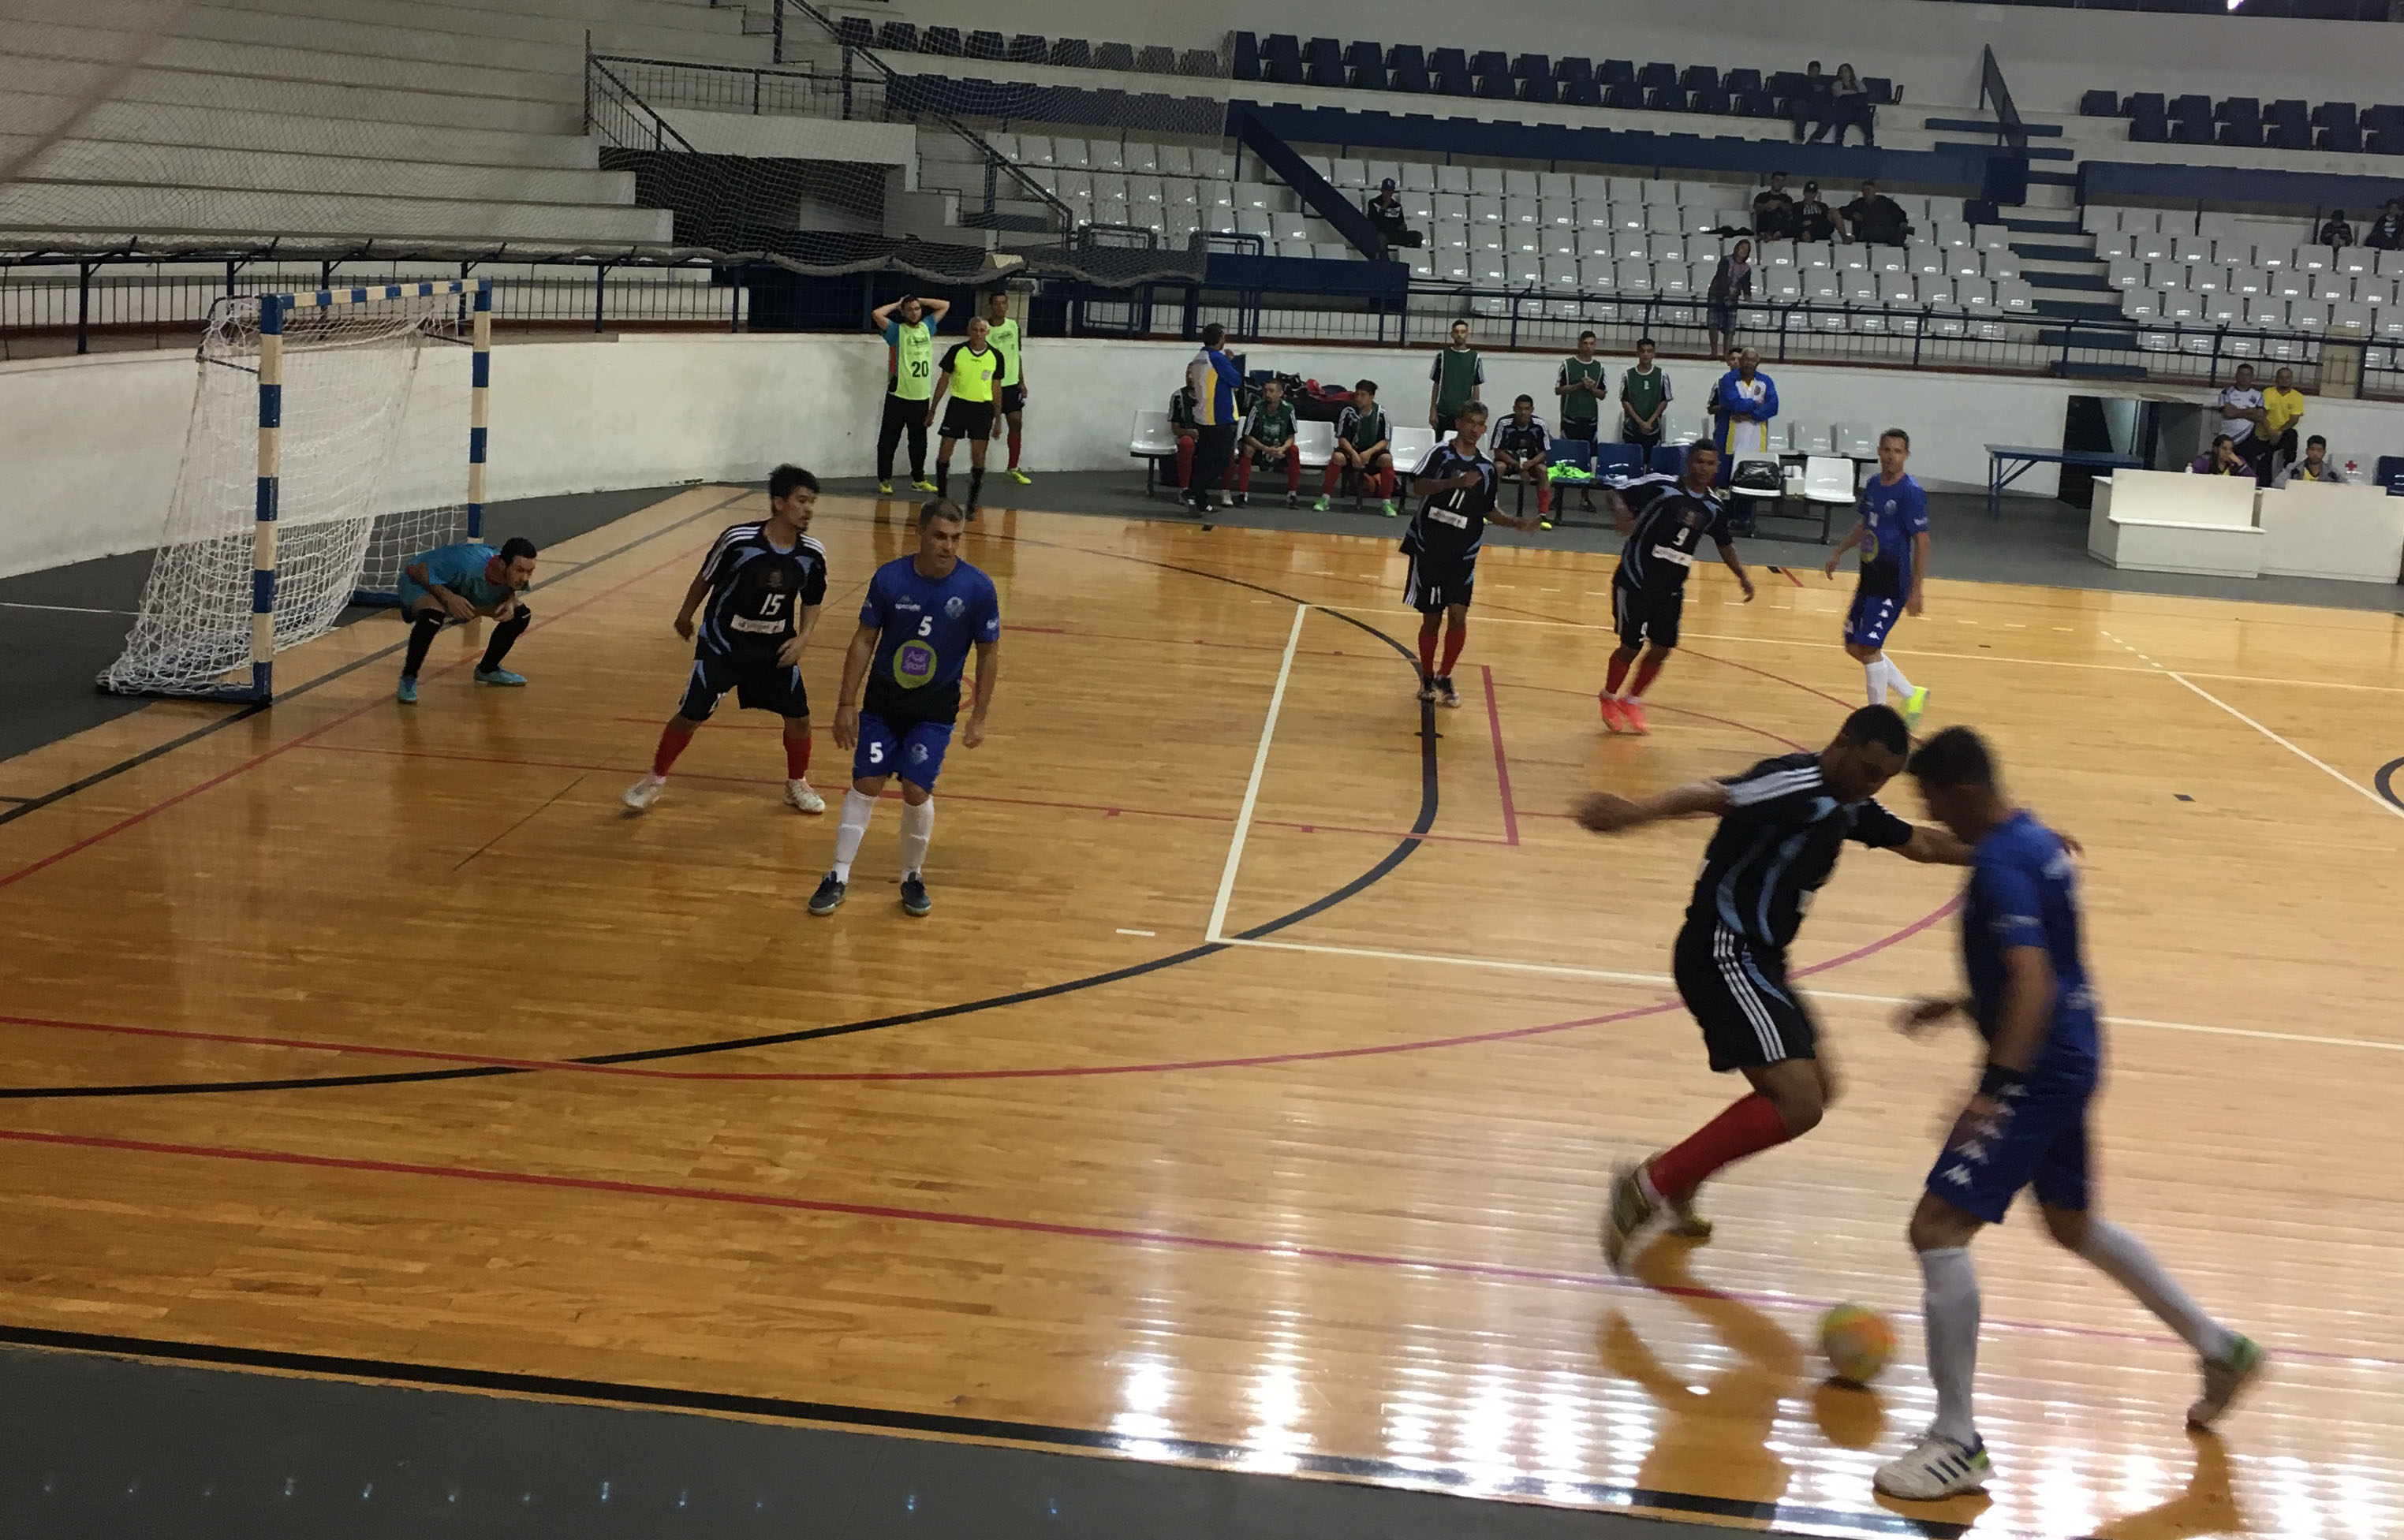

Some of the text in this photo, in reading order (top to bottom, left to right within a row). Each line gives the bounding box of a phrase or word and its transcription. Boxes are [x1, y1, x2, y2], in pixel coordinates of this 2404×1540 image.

[911, 360, 929, 378] 20
[1448, 488, 1466, 509] 11
[1672, 528, 1690, 546] 9
[759, 593, 787, 615] 15
[1429, 586, 1442, 606] 11
[917, 615, 933, 636] 5
[869, 741, 883, 763] 5
